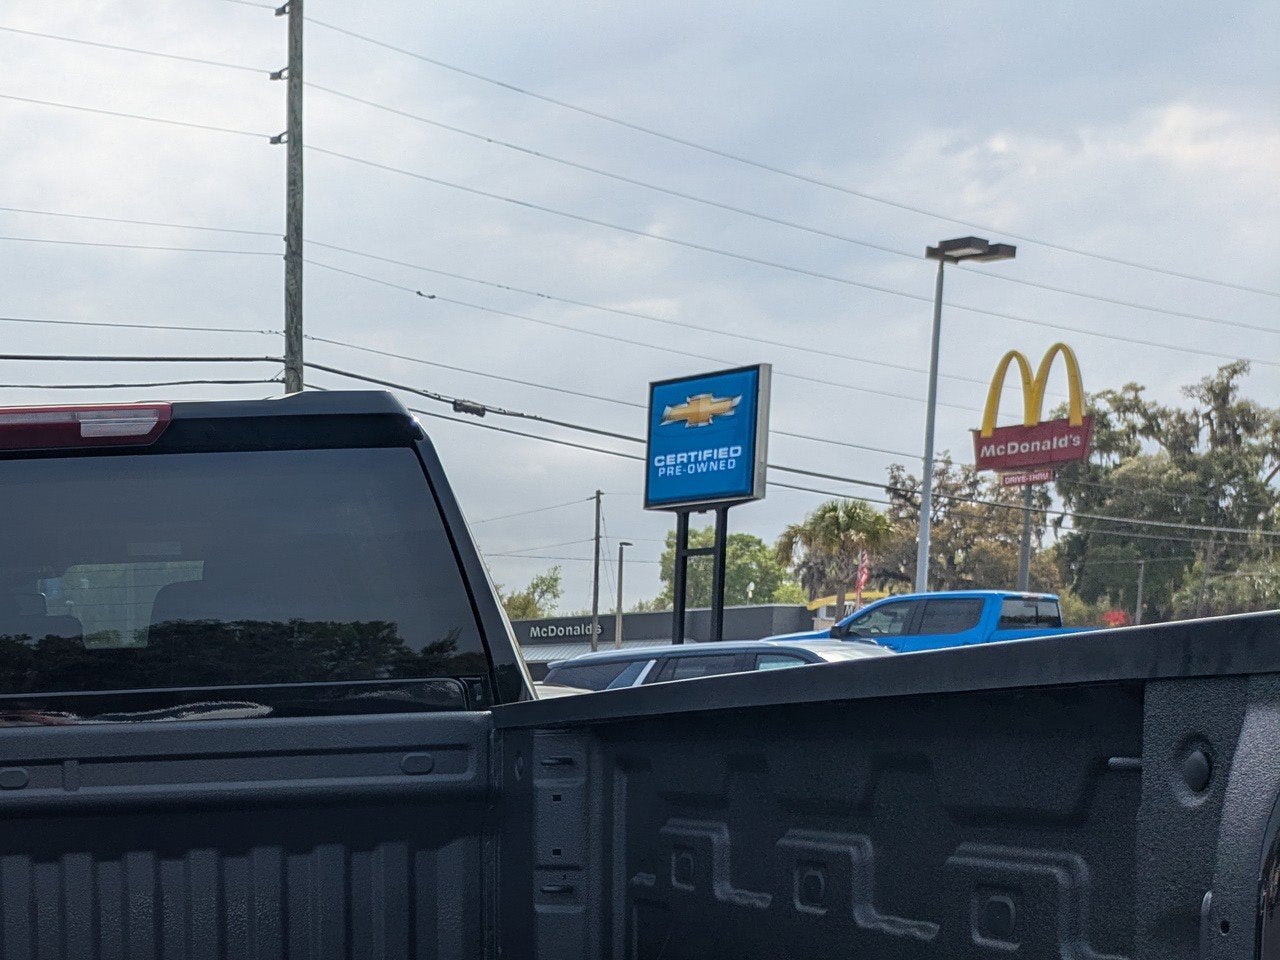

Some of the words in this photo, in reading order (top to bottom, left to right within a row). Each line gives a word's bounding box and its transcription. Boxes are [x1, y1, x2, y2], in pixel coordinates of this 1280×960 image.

[654, 445, 742, 467] CERTIFIED
[980, 434, 1081, 458] McDonald's
[658, 459, 736, 477] PRE-OWNED
[529, 623, 602, 638] McDonalds
